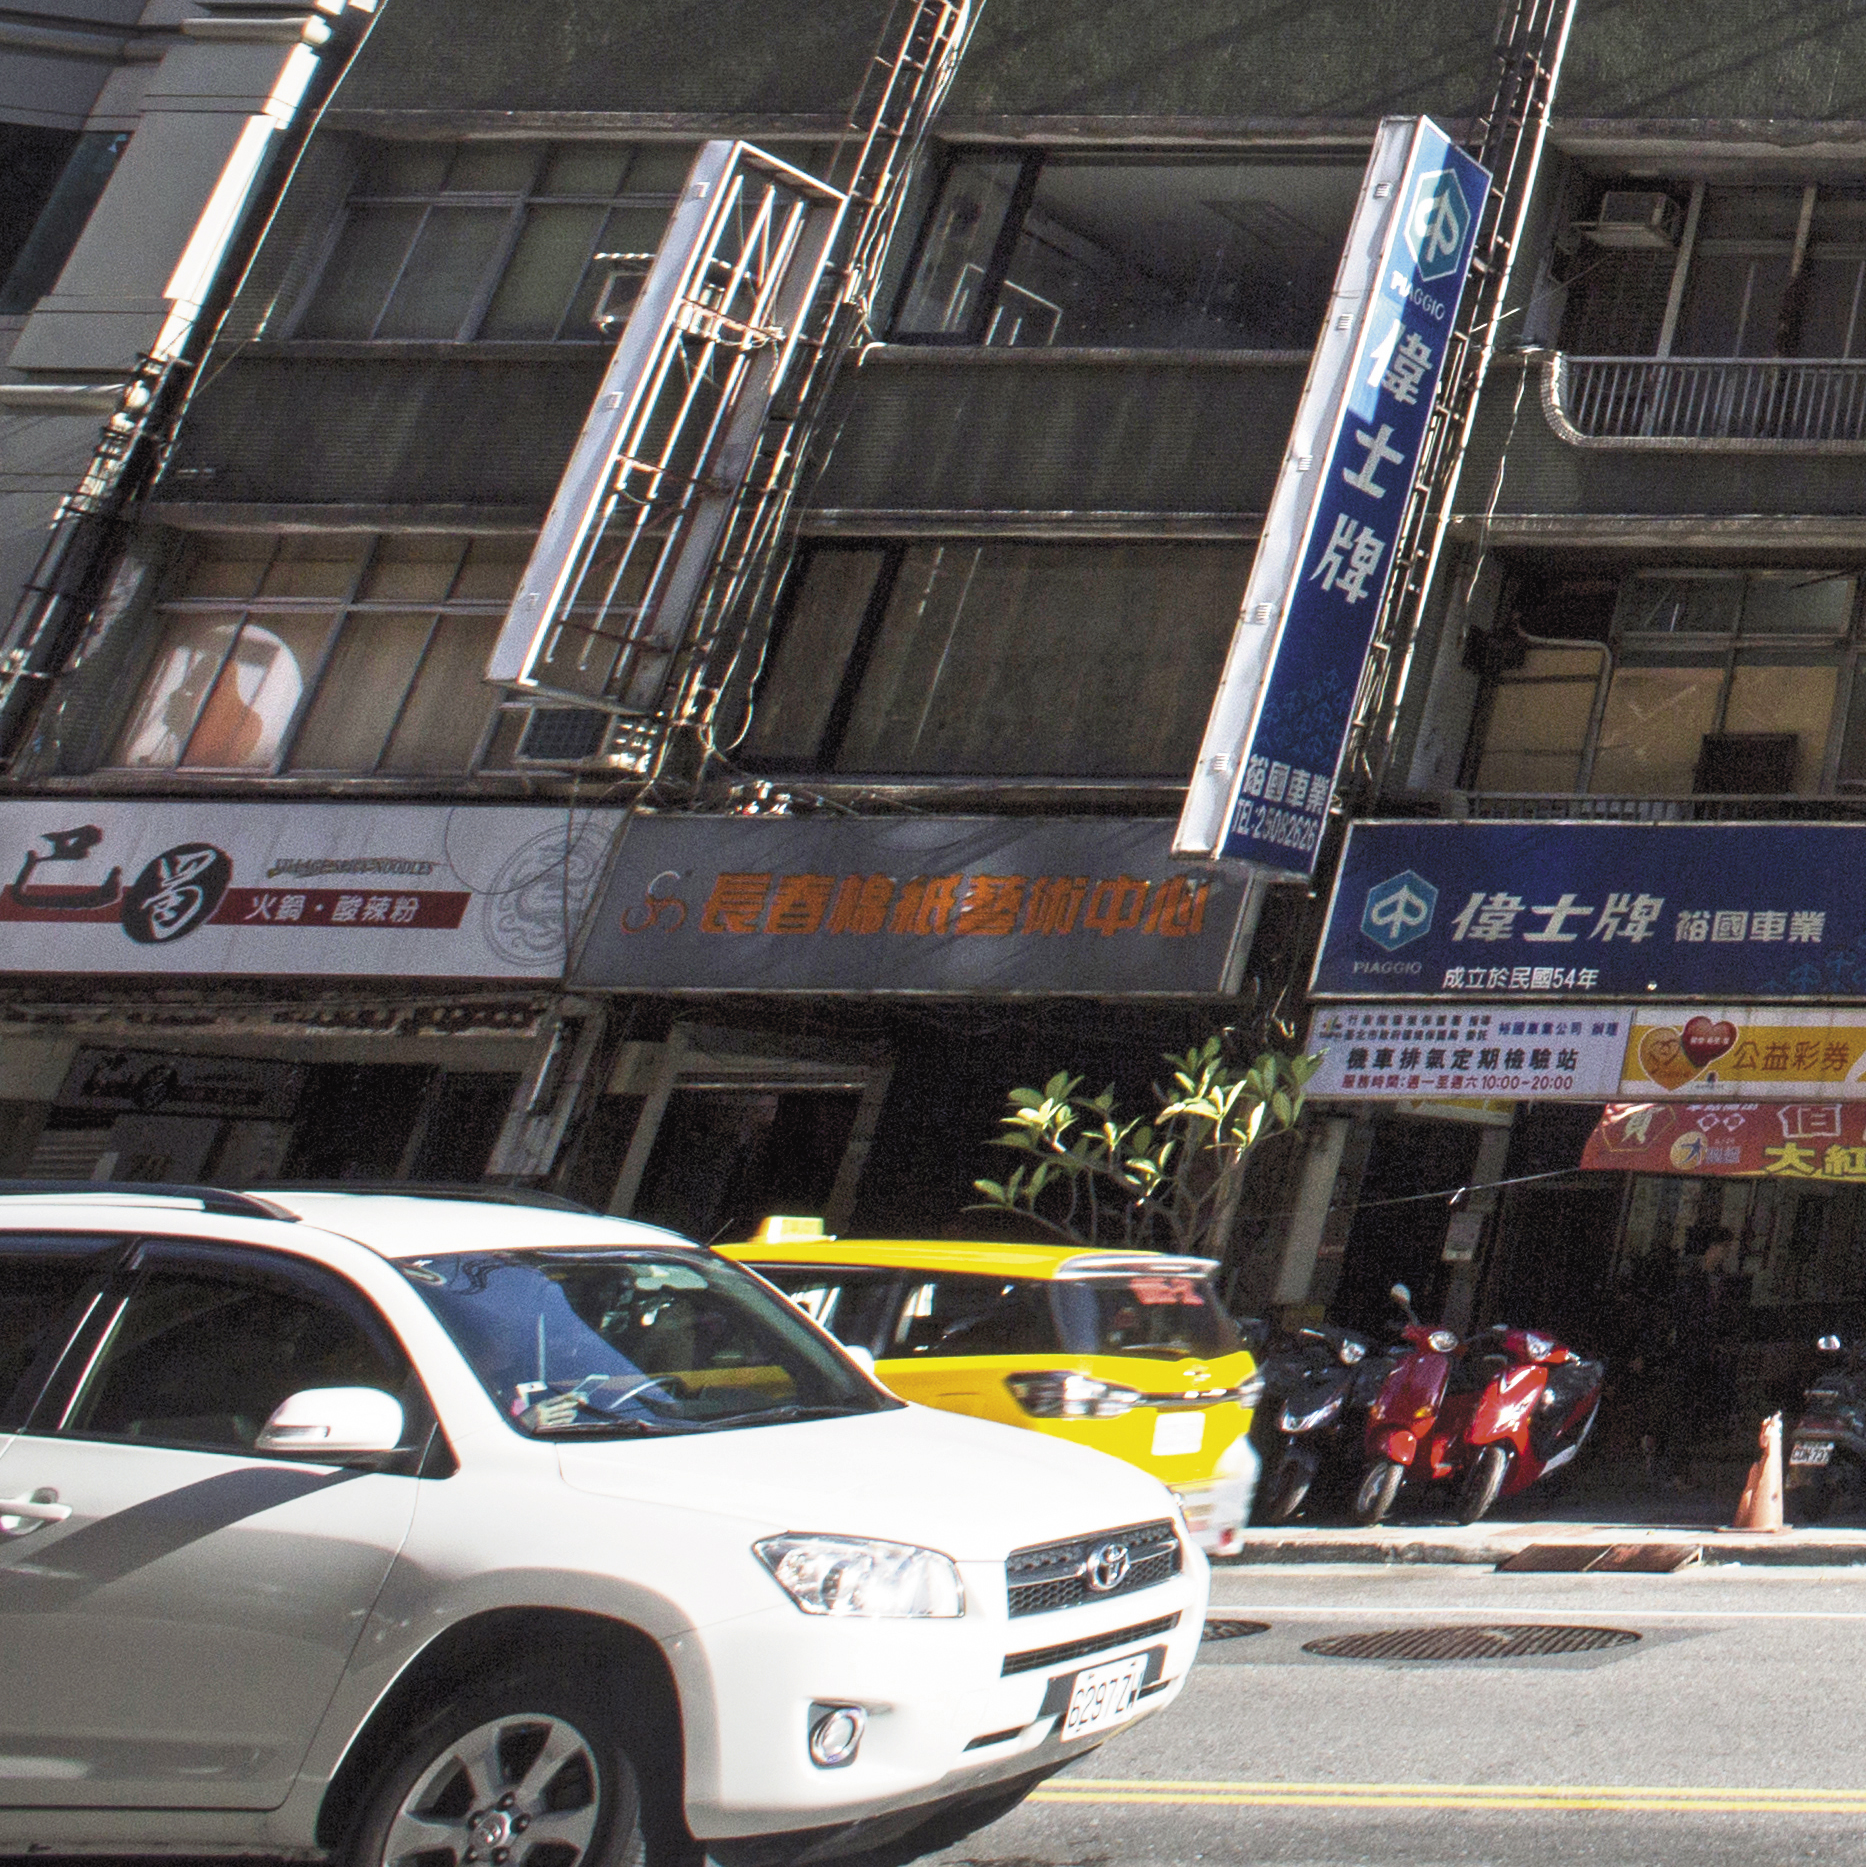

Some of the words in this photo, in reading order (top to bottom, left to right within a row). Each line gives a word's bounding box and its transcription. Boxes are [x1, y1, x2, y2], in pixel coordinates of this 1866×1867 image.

[1307, 317, 1435, 605] 偉士牌
[1238, 754, 1331, 814] 裕國車業
[8, 824, 216, 936] 巴蜀
[700, 871, 1210, 936] 長春棉紙藝術中心
[1450, 892, 1666, 943] 偉士牌
[1674, 908, 1828, 943] 裕國車業
[1352, 960, 1422, 976] PIAGGIO
[1441, 964, 1599, 992] 成立於民國54年
[1346, 1047, 1579, 1072] 機車排氣定期檢驗站
[1732, 1040, 1850, 1072] 公益彩券
